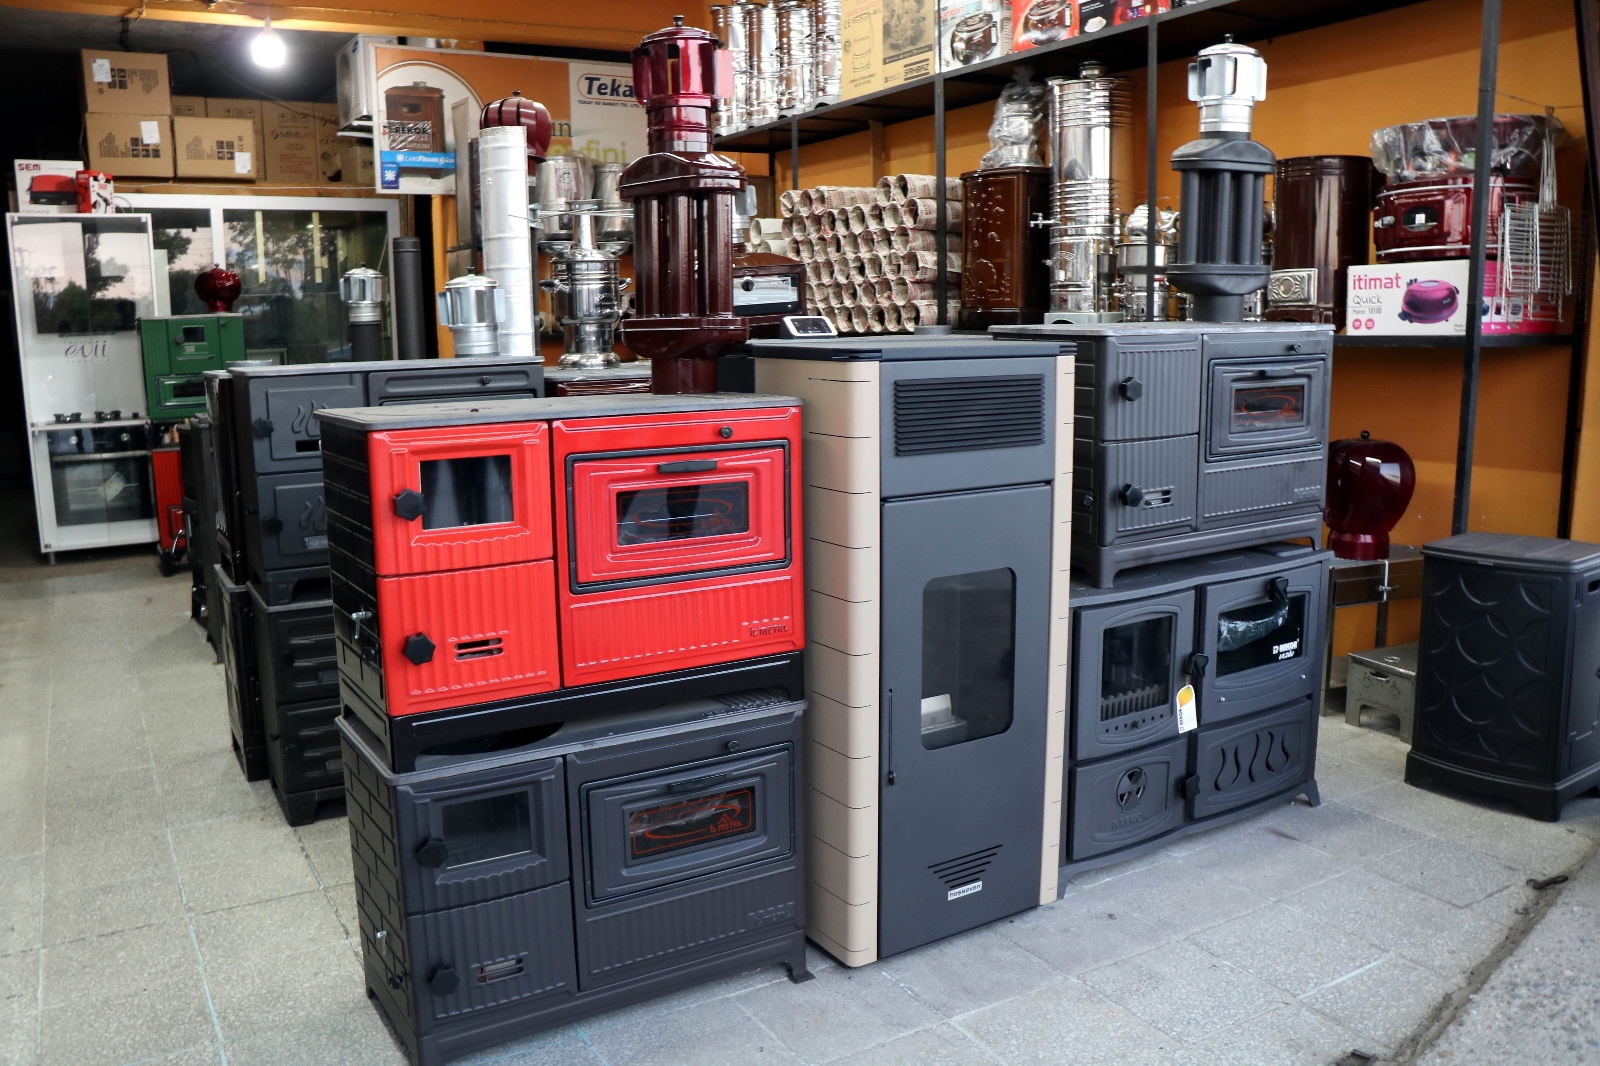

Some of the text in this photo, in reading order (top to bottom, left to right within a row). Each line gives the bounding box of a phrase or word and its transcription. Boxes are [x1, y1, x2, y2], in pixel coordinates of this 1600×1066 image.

[584, 76, 635, 98] Teka
[18, 163, 41, 171] SEM
[1353, 272, 1401, 291] itimat
[1352, 293, 1383, 306] Quick
